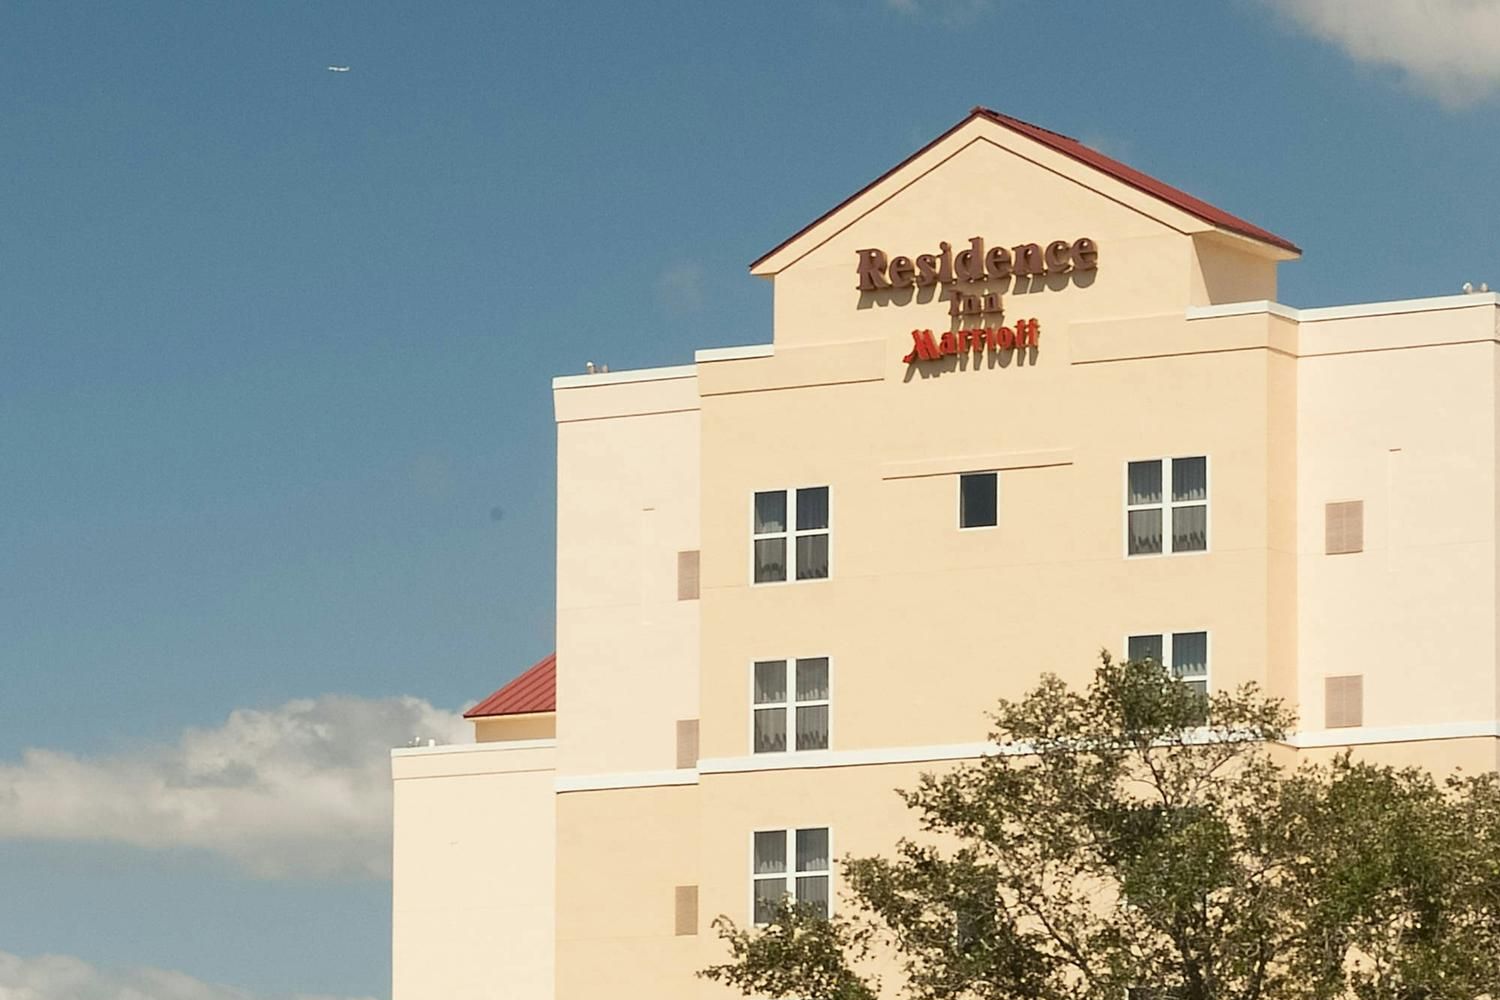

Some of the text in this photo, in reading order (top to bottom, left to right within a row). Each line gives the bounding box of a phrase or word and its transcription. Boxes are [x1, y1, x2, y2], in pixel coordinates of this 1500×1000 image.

[855, 236, 1098, 291] Residence
[948, 289, 1004, 316] Inn
[903, 318, 1040, 363] Marriott
